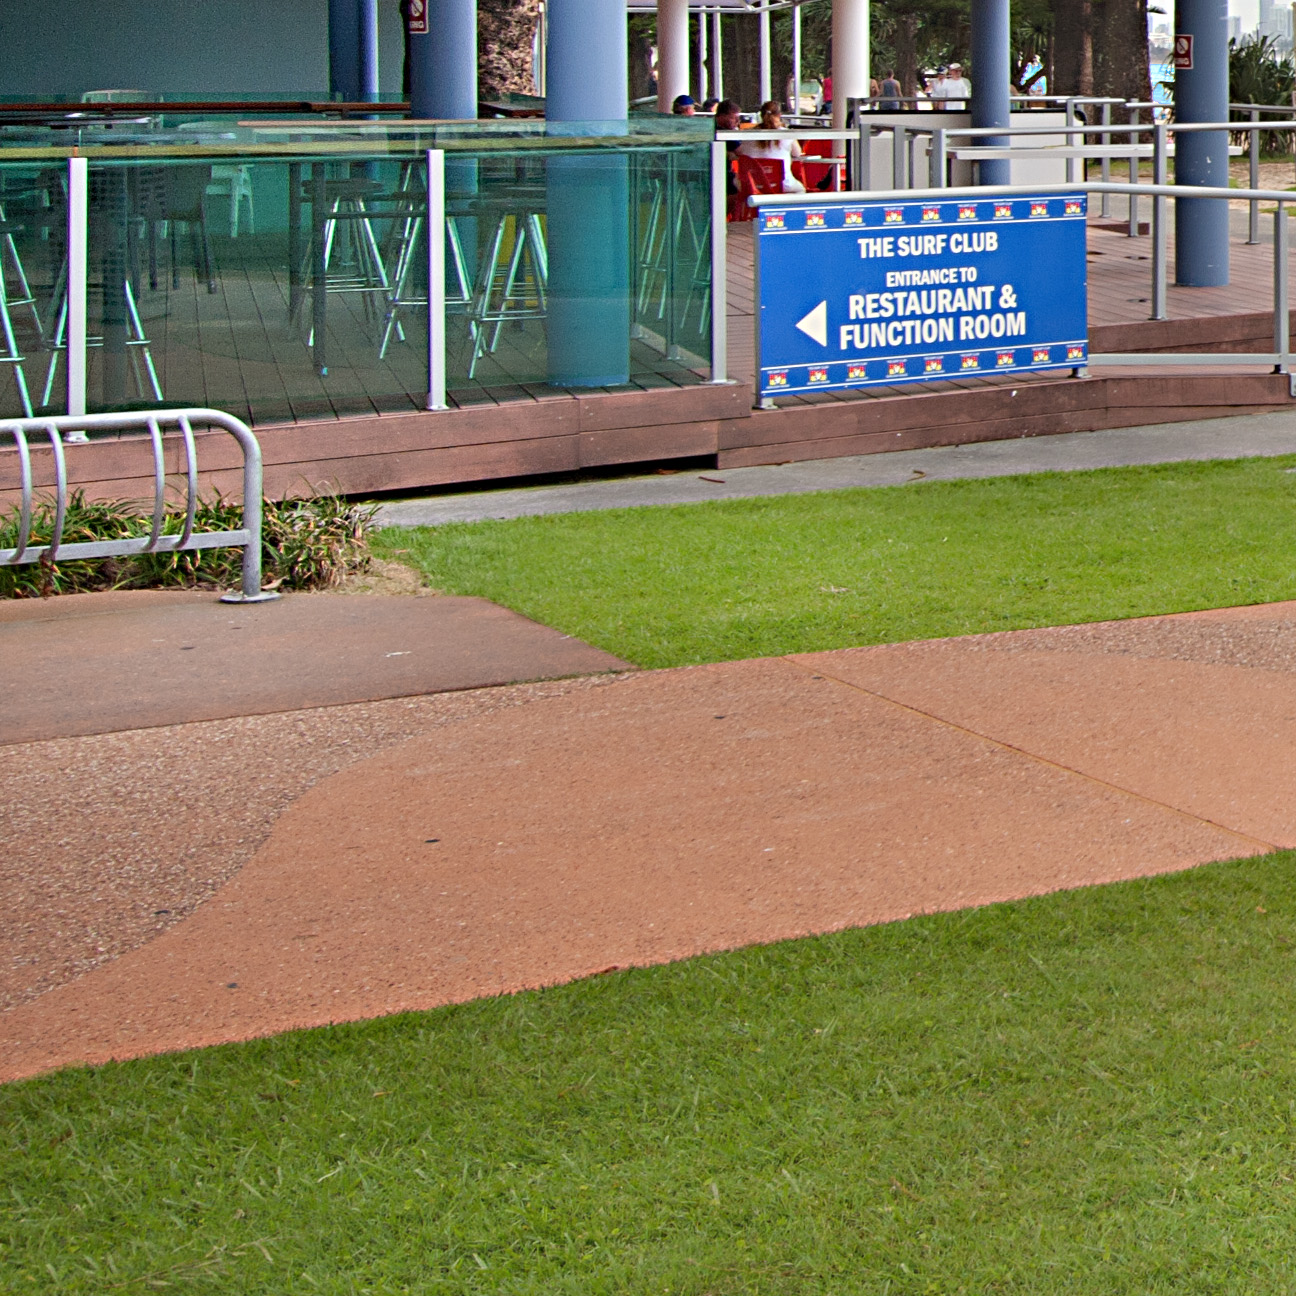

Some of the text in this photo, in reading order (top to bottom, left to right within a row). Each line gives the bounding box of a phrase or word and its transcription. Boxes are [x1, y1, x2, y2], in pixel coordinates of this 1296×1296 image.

[857, 231, 999, 259] THE SURF CLUB
[886, 266, 977, 288] ENTRANCE TO
[849, 284, 1018, 320] RESTAURANT &
[839, 311, 1027, 351] FUNCTION ROOM
